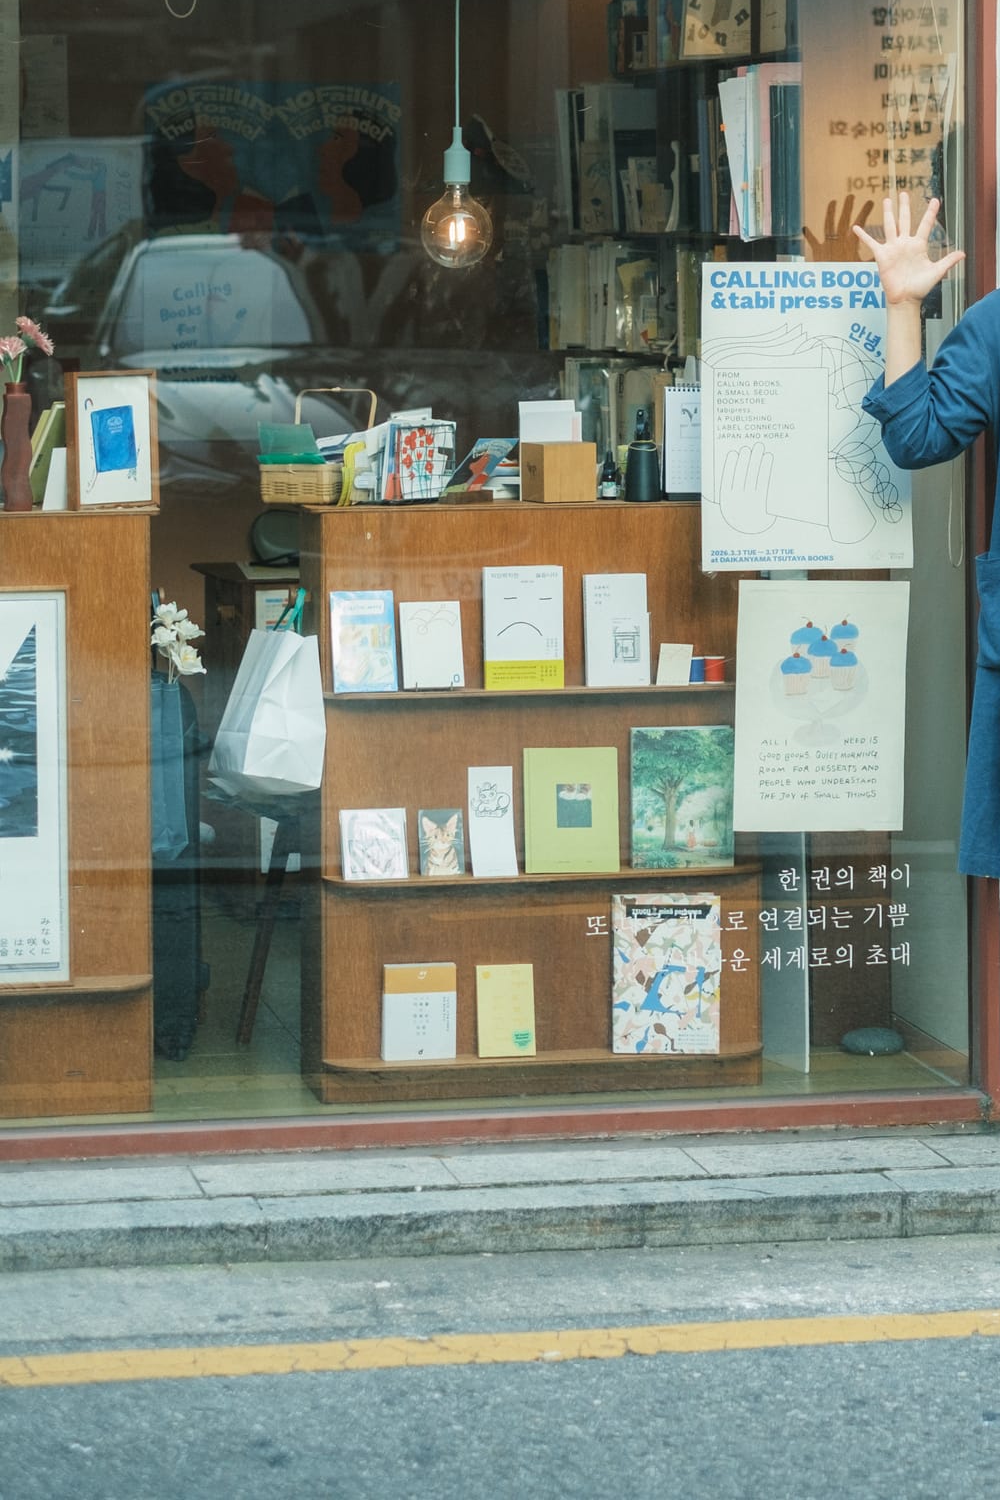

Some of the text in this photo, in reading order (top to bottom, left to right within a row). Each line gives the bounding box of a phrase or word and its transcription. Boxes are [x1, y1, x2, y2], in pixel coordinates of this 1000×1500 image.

[710, 271, 816, 288] CALLING
[172, 282, 232, 301] Calling
[160, 305, 203, 322] Books
[780, 296, 843, 313] press
[861, 764, 880, 772] AND
[778, 863, 911, 892] 한 권의 책이
[585, 914, 609, 937] 또
[758, 905, 855, 933] 연결되는
[863, 902, 910, 928] 기쁨
[760, 943, 855, 972] 세계로의
[865, 941, 911, 968] 초대
